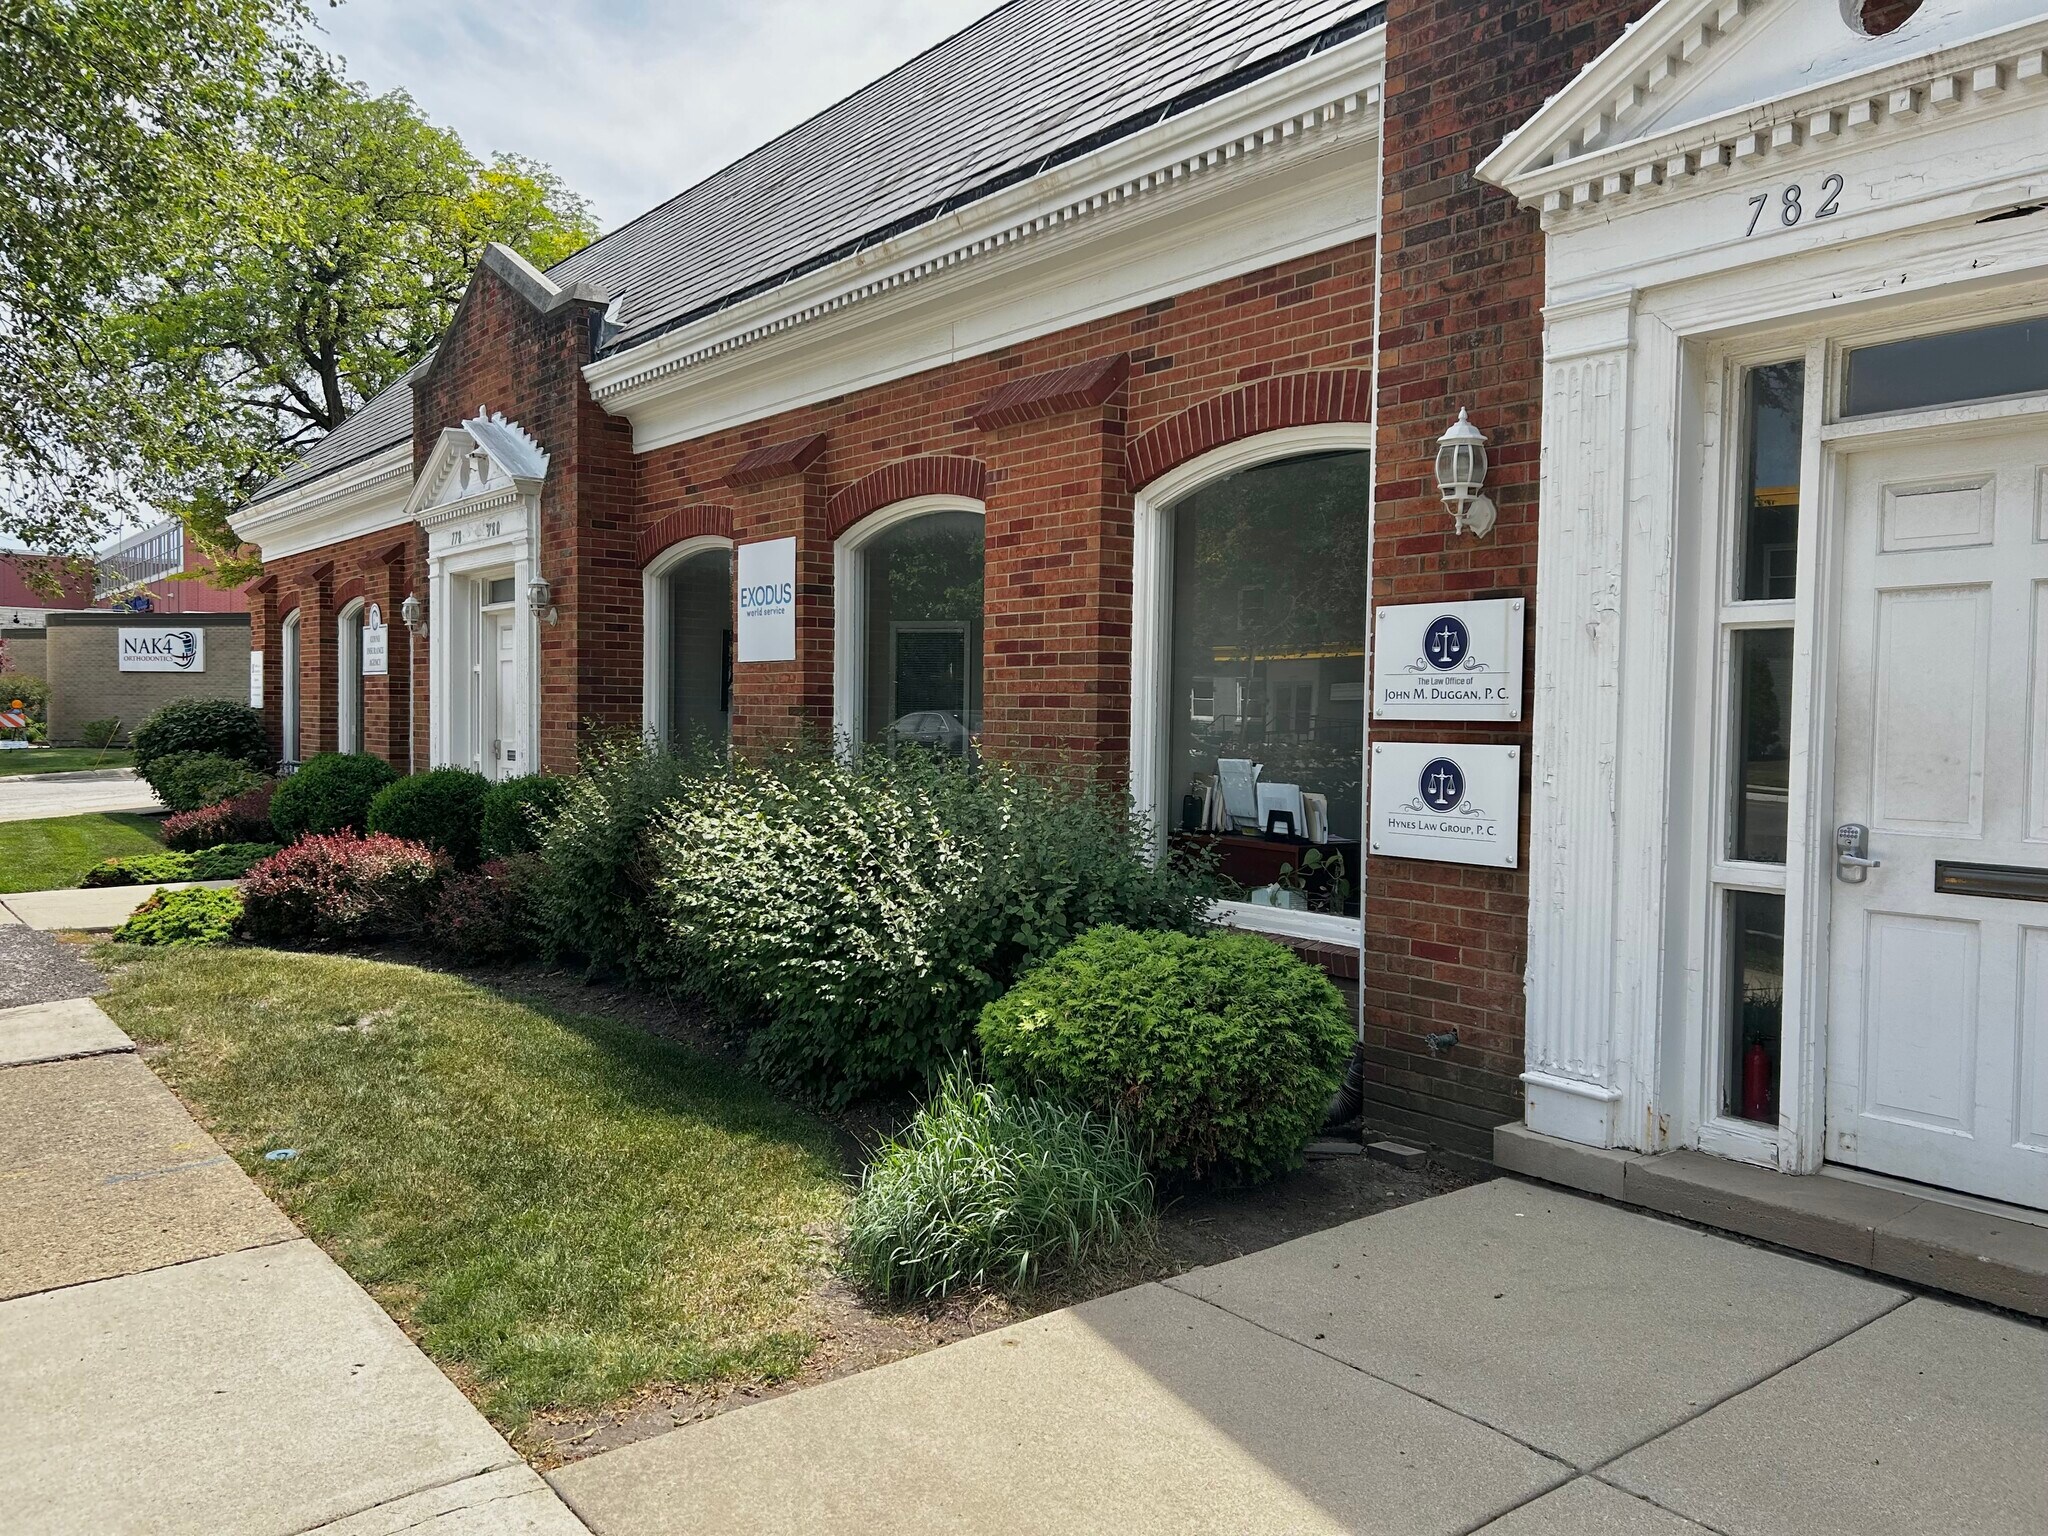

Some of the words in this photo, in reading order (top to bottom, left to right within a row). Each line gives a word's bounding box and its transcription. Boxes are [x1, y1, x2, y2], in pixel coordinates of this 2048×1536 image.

[1746, 173, 1844, 237] 782
[452, 530, 461, 546] 778
[486, 521, 500, 537] 780
[741, 583, 792, 608] EXODUS
[747, 607, 763, 617] world
[764, 606, 785, 616] service
[124, 637, 173, 655] NAK4
[1418, 677, 1430, 686] The
[1431, 677, 1444, 686] Law
[1445, 676, 1465, 685] Office
[1466, 676, 1473, 685] of
[1385, 688, 1410, 702] JOHN
[1413, 688, 1428, 700] M.
[1431, 688, 1481, 700] DUGGAN,
[1485, 687, 1494, 700] P.
[1497, 687, 1509, 700] C.
[1388, 818, 1416, 830] HYNES
[1418, 820, 1437, 831] LAW
[1440, 822, 1474, 835] GROUP,
[1476, 825, 1484, 835] P.
[1487, 826, 1497, 836] C.
